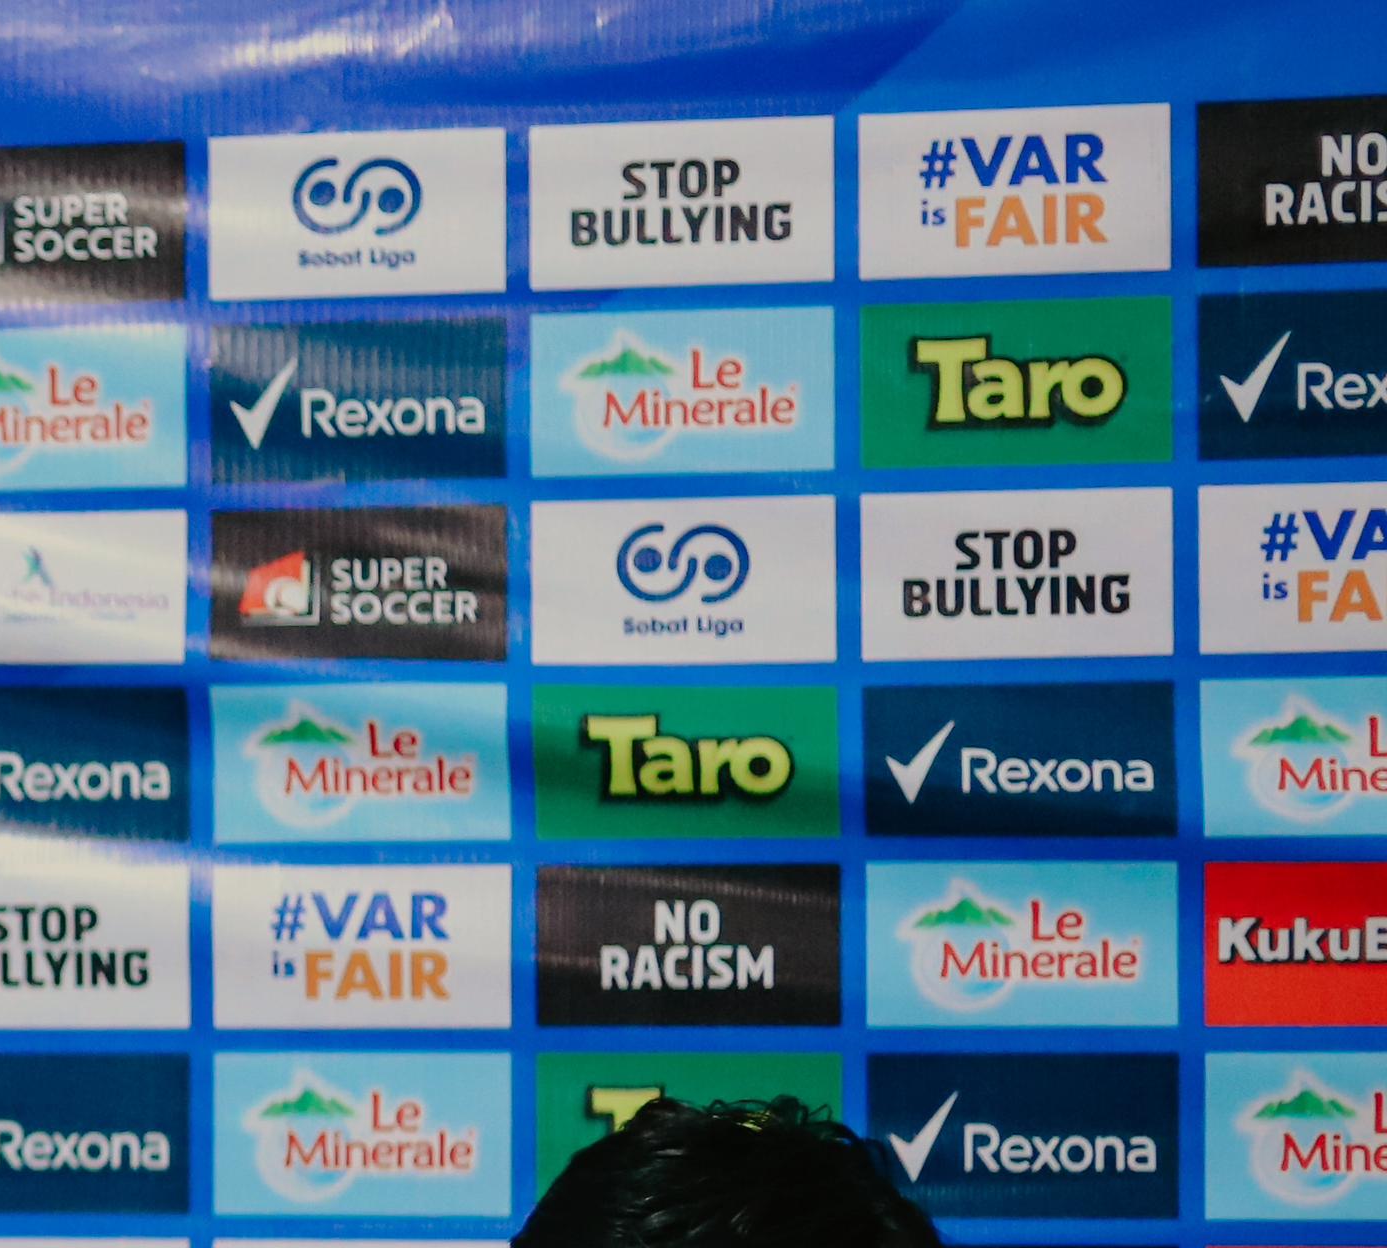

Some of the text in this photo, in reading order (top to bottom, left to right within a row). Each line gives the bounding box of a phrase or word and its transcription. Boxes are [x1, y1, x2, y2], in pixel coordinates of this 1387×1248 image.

[919, 134, 1106, 190] #VAR
[1320, 134, 1387, 176] NO
[621, 159, 740, 200] STOP
[14, 193, 128, 229] SUPER
[570, 203, 792, 248] BULLYING
[920, 195, 1109, 249] is FAIR
[14, 225, 158, 263] SOCCER
[361, 249, 416, 270] Liga
[47, 364, 100, 408] Le
[691, 349, 743, 390] Le
[915, 336, 1127, 426] Taro
[301, 388, 486, 436] Rexona
[602, 384, 796, 429] Minerale
[954, 528, 1076, 572] STOP
[330, 558, 448, 591] SUPER
[902, 574, 1131, 618] BULLYING
[1262, 573, 1290, 600] is
[330, 591, 479, 625] SOCCER
[623, 615, 744, 636] Sobat Liga
[369, 721, 419, 759] Le
[583, 715, 795, 798] Taro
[284, 753, 474, 795] Minerale
[961, 748, 1154, 793] Rexona
[272, 892, 448, 942] #VAR
[653, 899, 720, 943] NO
[1031, 901, 1083, 942] Le
[272, 951, 450, 1001] is FAIR
[600, 944, 775, 991] RACISM
[940, 939, 1138, 981] Minerale
[369, 1091, 421, 1131] Le
[285, 1128, 474, 1172] Minerale
[962, 1122, 1157, 1173] Rexona
